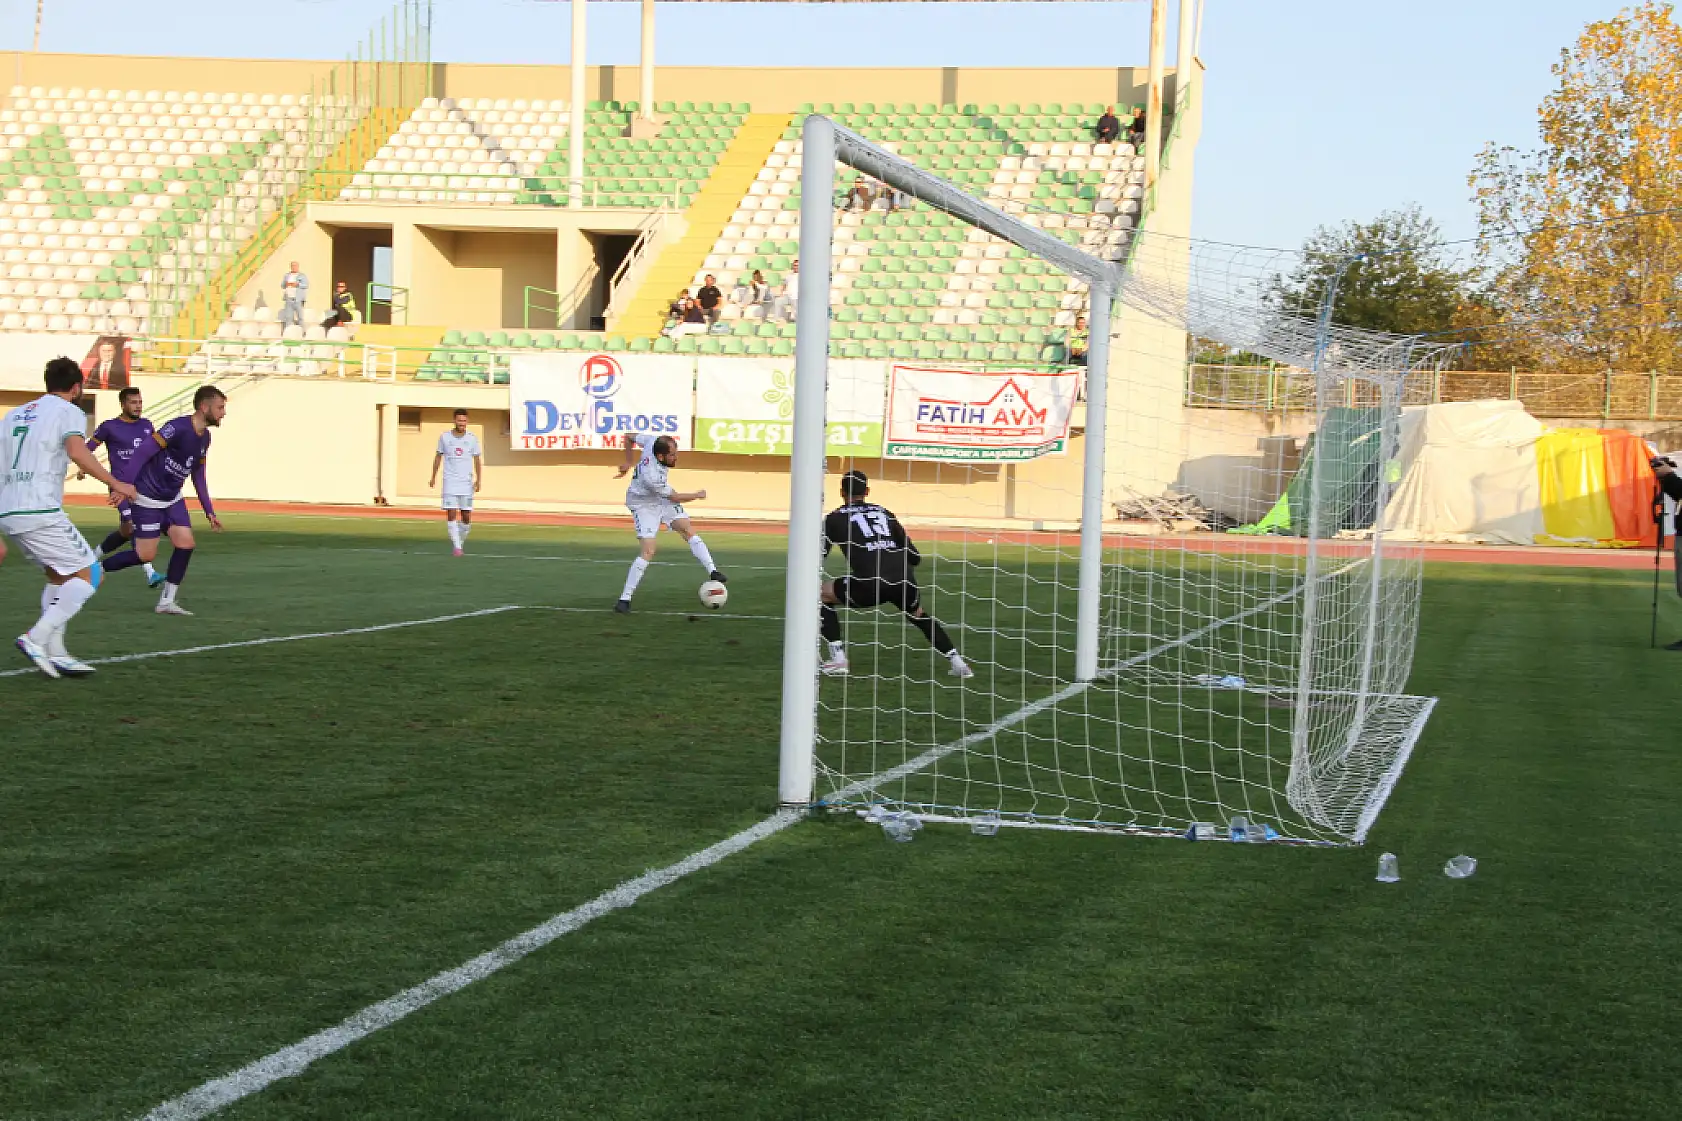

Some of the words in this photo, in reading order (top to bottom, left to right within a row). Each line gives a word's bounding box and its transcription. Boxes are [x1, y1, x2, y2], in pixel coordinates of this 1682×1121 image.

[589, 400, 678, 434] GROSS
[917, 403, 985, 424] FATİH
[992, 408, 1047, 426] AVM
[12, 426, 29, 469] 7
[521, 436, 592, 449] TOPTAN
[849, 511, 892, 537] 13
